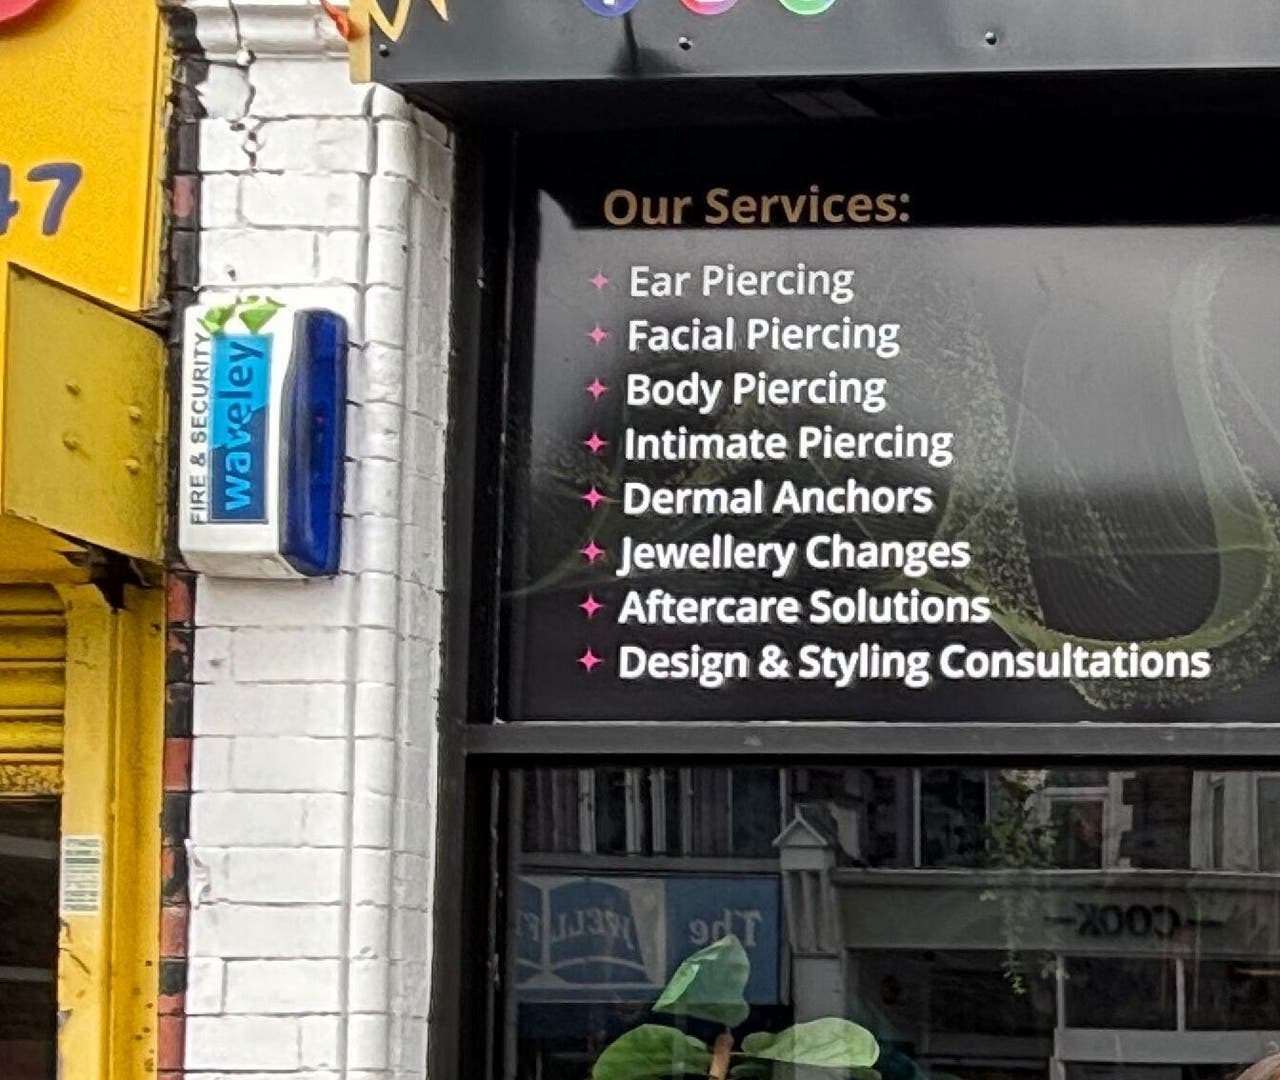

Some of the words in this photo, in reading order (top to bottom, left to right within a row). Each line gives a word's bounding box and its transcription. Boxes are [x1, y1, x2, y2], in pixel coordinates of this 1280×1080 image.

[603, 189, 692, 226] Our
[704, 184, 910, 225] Services:
[630, 265, 691, 297] Ear
[702, 262, 855, 305] Piercing
[628, 316, 735, 352] Facial
[747, 315, 901, 359] Piercing
[191, 332, 210, 444] SECURITY
[627, 371, 723, 415] Body
[733, 370, 888, 414] Piercing
[218, 341, 264, 512] waveley
[625, 426, 788, 461] Intimate
[799, 423, 955, 468] Piercing
[190, 454, 206, 467] &
[190, 475, 207, 525] FIRE
[623, 478, 764, 515] Dermal
[772, 478, 934, 514] Anchors
[615, 533, 798, 578] Jewellery
[806, 533, 972, 578] Changes
[617, 588, 801, 625] Aftercare
[809, 587, 995, 624] Solutions
[619, 644, 750, 689] Design
[758, 644, 791, 679] &
[798, 642, 931, 688] Styling
[939, 641, 1211, 679] Consultations
